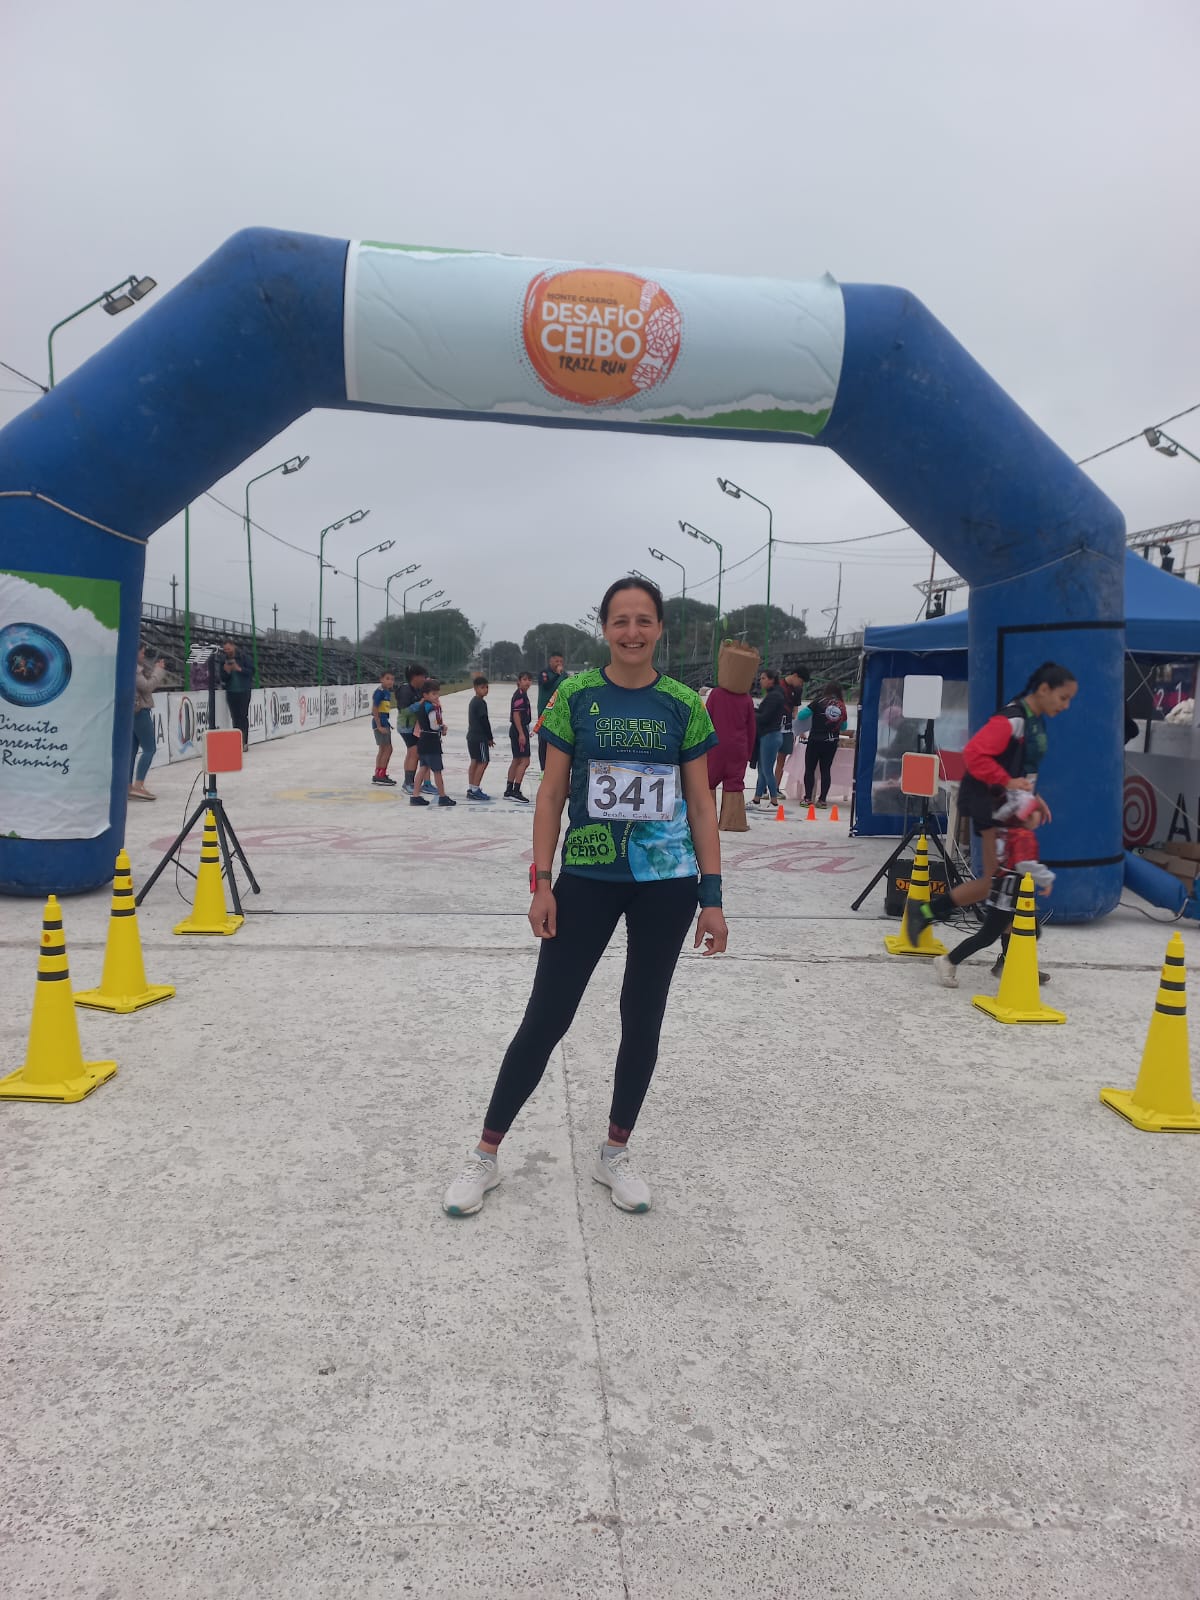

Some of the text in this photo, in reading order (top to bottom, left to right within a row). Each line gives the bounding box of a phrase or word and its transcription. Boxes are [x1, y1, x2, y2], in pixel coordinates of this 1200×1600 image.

[542, 302, 644, 329] DESAFÍO
[540, 323, 642, 359] CEIBO
[559, 355, 627, 375] TRAIL RUN
[595, 717, 667, 734] GREEN
[595, 731, 667, 750] TRAIL
[2, 749, 70, 775] Running
[594, 775, 665, 812] 341
[568, 831, 608, 845] DESAFÍO
[570, 843, 610, 858] CEIBO
